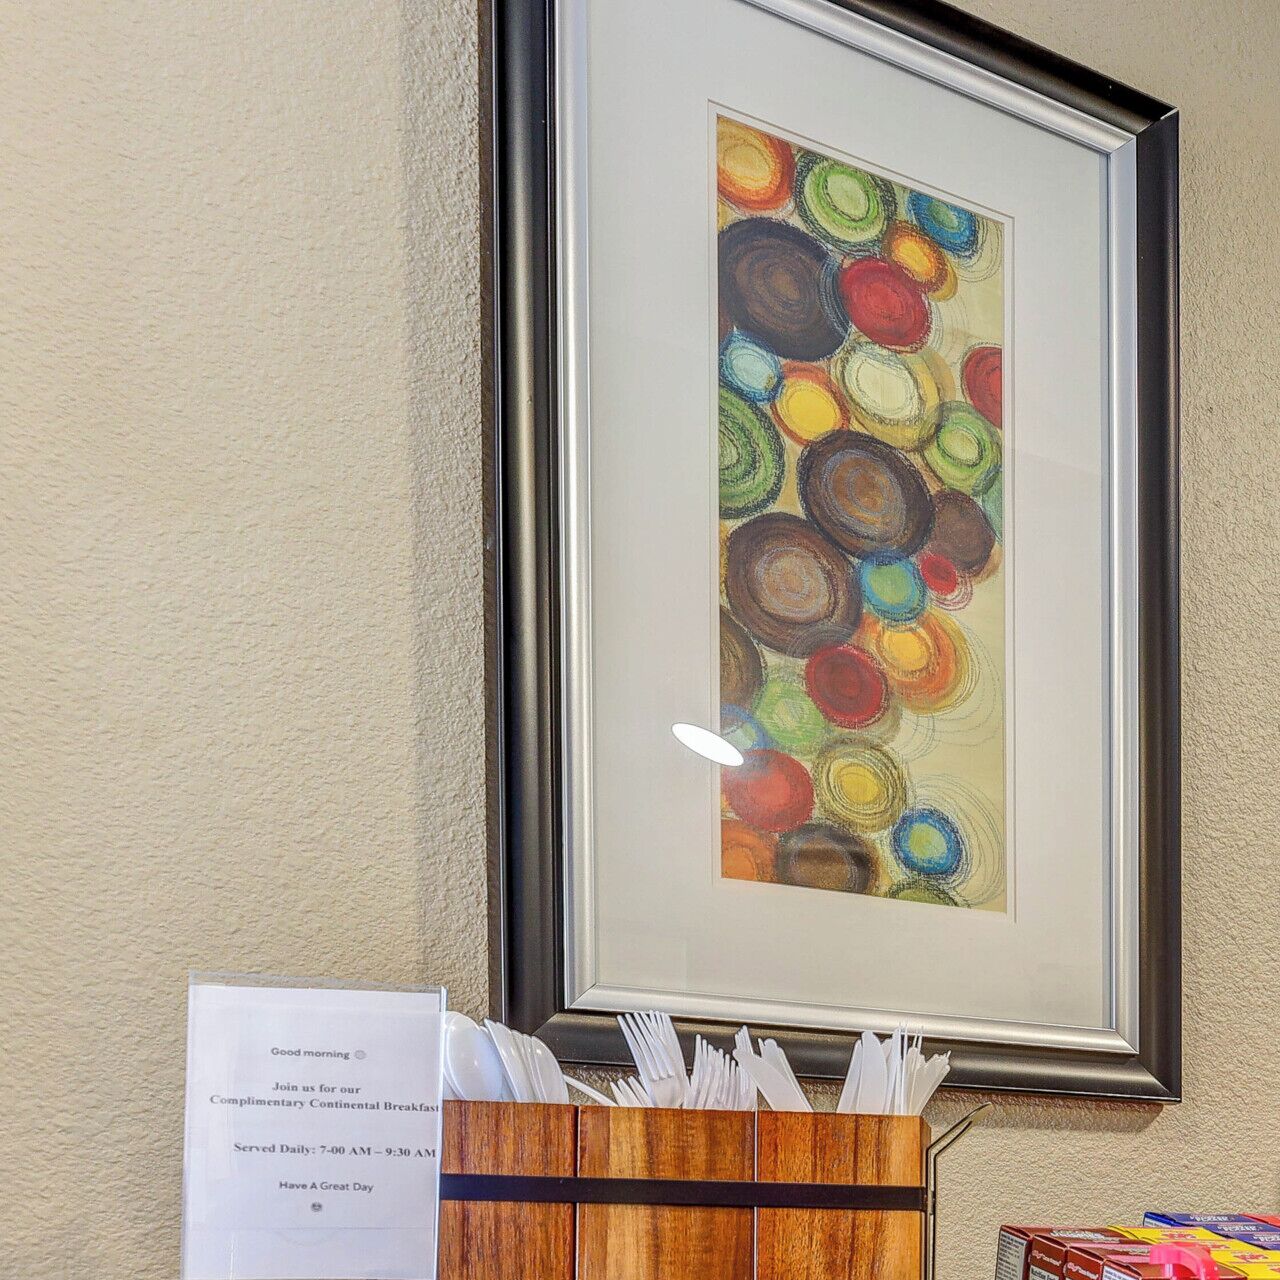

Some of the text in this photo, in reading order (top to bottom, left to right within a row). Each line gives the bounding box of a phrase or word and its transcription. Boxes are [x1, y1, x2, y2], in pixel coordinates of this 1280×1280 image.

[271, 1047, 350, 1060] Good morning
[272, 1082, 361, 1094] Join us for our
[210, 1095, 439, 1113] Complimentary Continental Breakfast
[234, 1143, 276, 1154] Served
[280, 1144, 316, 1156] Daily:
[349, 1147, 372, 1156] AM
[386, 1148, 411, 1157] 9:30
[414, 1148, 436, 1158] AM
[279, 1181, 374, 1194] Have A Great Day
